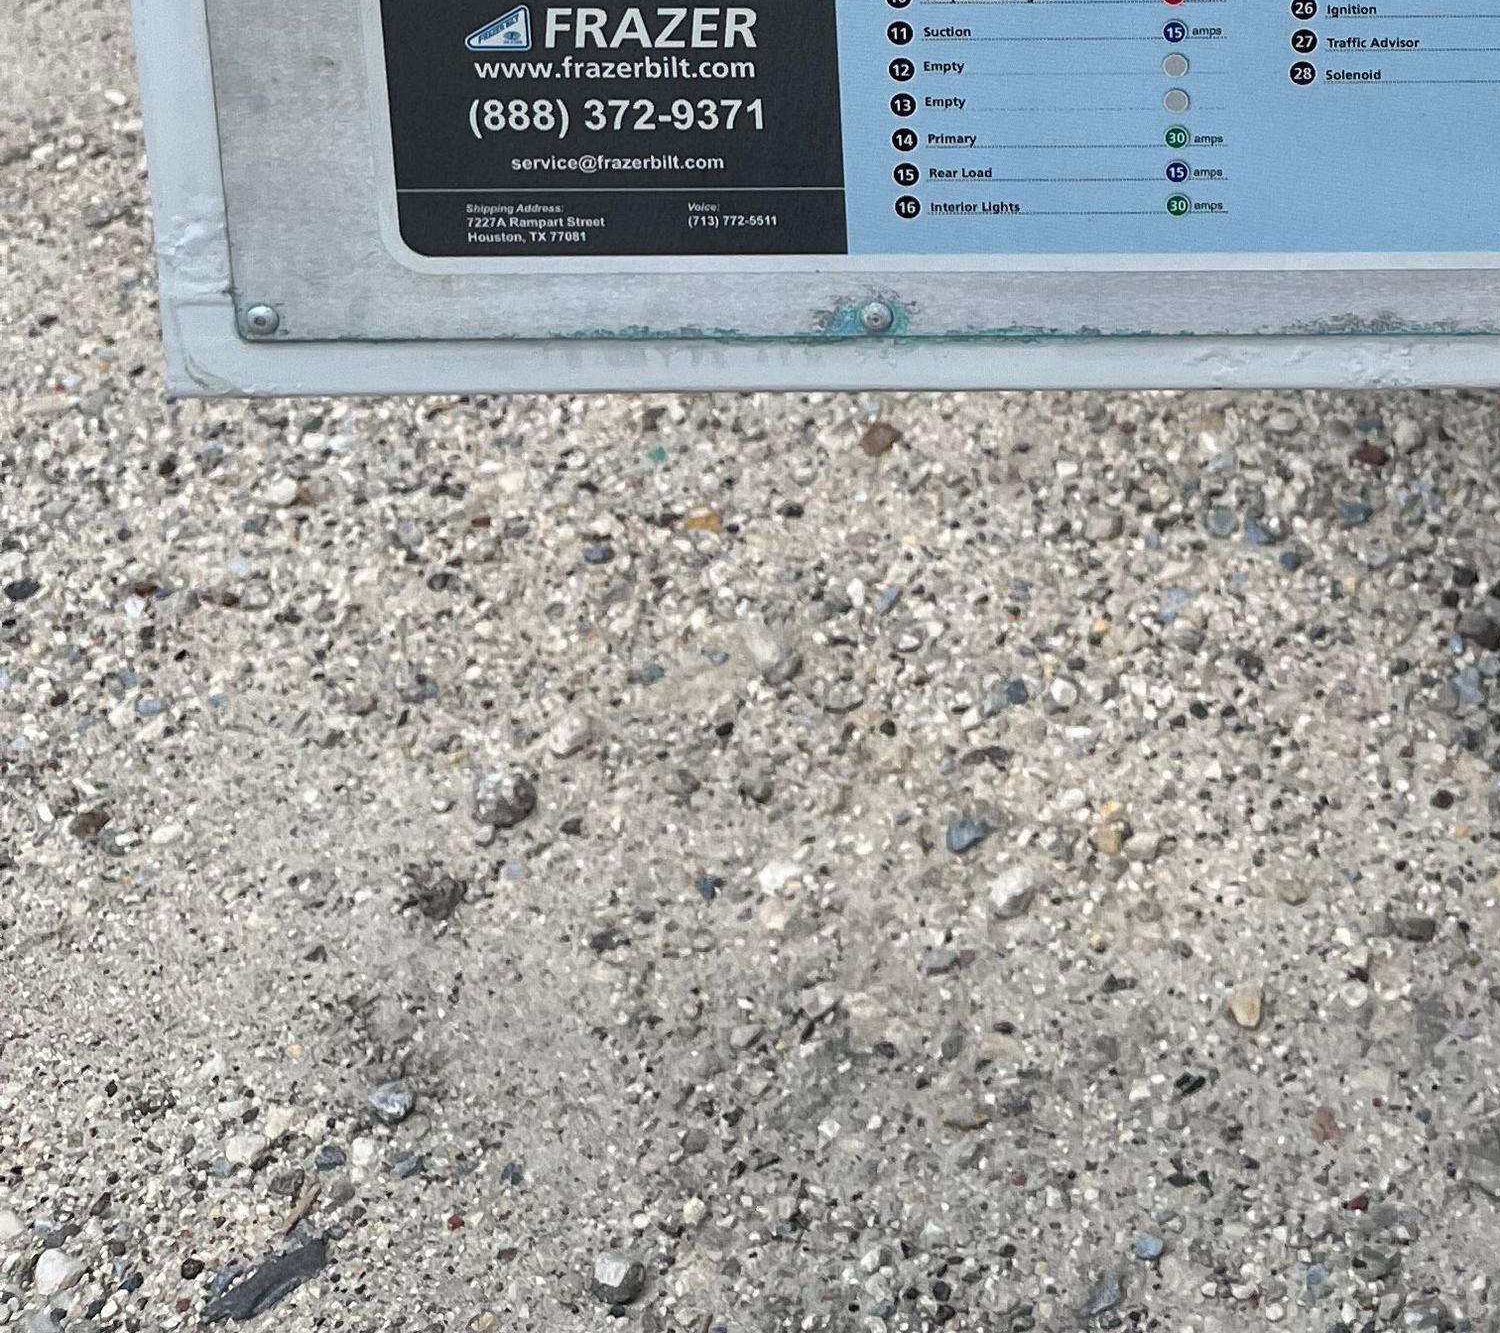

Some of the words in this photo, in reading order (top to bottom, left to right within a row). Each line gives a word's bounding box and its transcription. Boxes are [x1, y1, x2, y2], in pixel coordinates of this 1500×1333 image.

[546, 8, 756, 48] FRAZER
[1295, 35, 1314, 48] 27
[1326, 36, 1367, 49] Traffic
[1369, 36, 1420, 48] Advisor
[474, 55, 755, 79] www.frazerbilt.com
[470, 99, 568, 138] (888)
[584, 99, 762, 130] 372-9371
[511, 154, 724, 174] service@frazerbilt.com
[467, 216, 507, 228] 7227A
[509, 216, 564, 230] Rampart
[566, 216, 605, 227] Street
[688, 215, 719, 229] (713)
[722, 214, 777, 226] 772-5511
[467, 232, 526, 244] Houston,
[529, 231, 547, 242] TX
[549, 231, 586, 242] 77081
